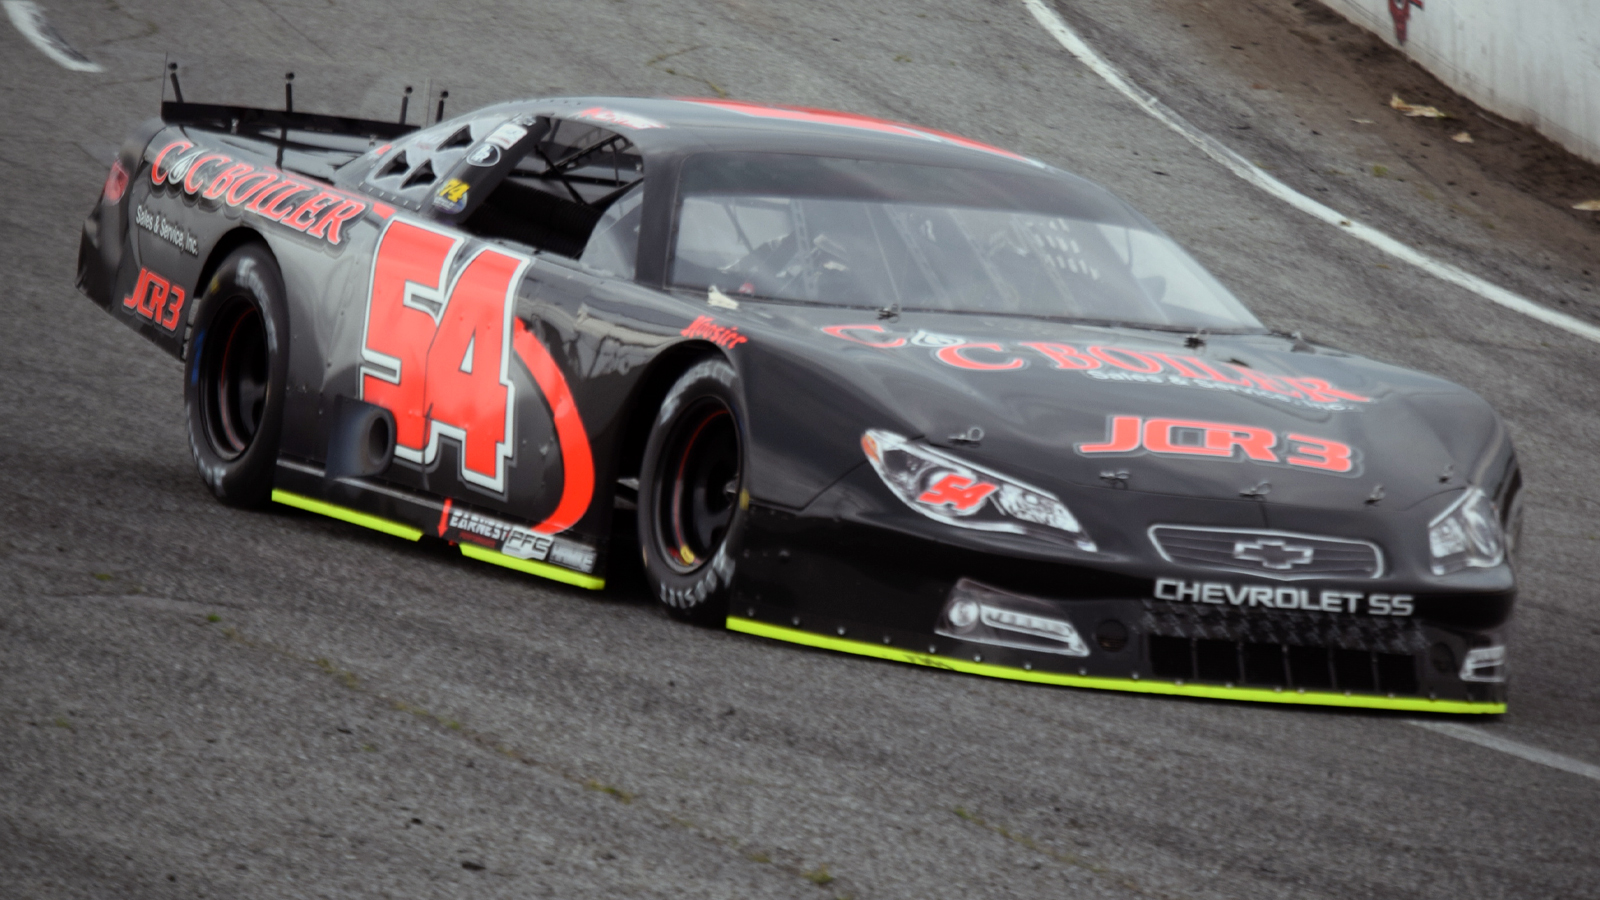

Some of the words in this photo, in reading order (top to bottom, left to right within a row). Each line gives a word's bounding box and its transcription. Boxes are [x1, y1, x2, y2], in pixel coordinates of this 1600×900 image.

[203, 163, 366, 245] BOILER
[136, 205, 153, 231] Sales
[154, 215, 160, 234] &
[160, 217, 184, 252] Service,
[185, 231, 198, 256] Inc.
[360, 216, 531, 494] 54
[1019, 342, 1371, 403] BOILER
[1087, 369, 1163, 384] Sales
[918, 473, 999, 511] 54
[448, 514, 509, 542] EARNEST
[1154, 577, 1364, 614] CHEVROLET
[1368, 593, 1414, 617] SS
